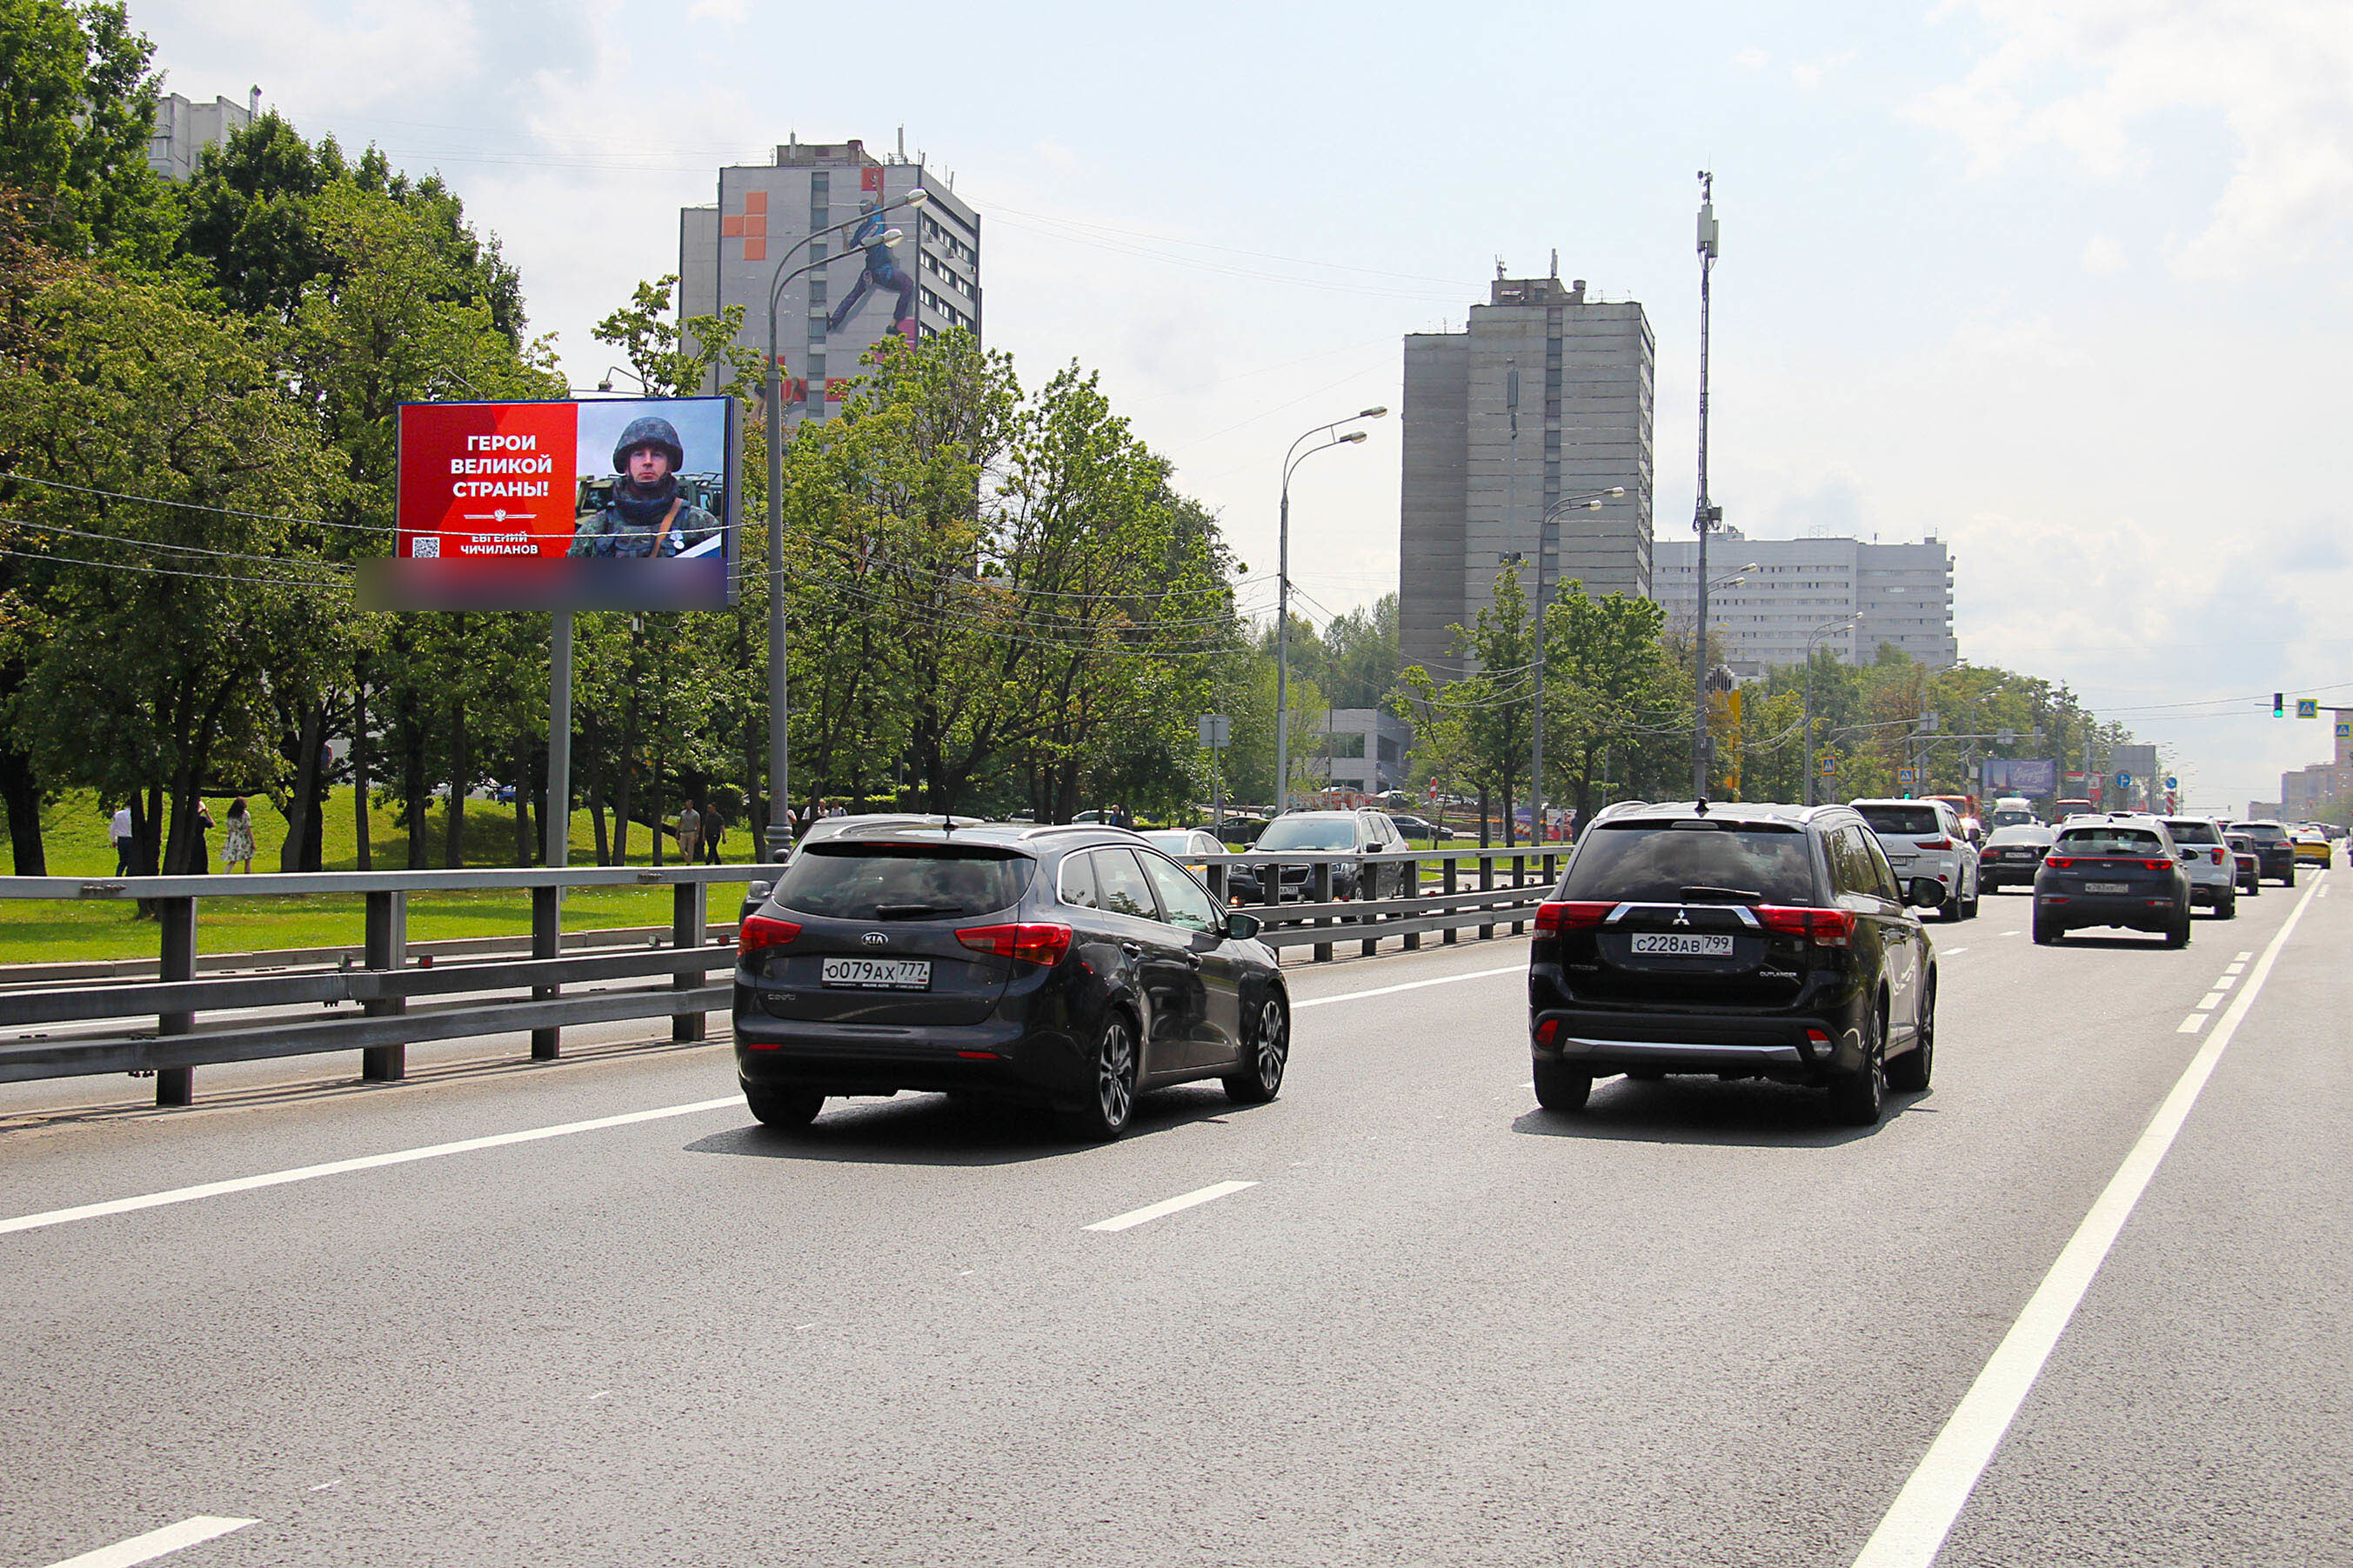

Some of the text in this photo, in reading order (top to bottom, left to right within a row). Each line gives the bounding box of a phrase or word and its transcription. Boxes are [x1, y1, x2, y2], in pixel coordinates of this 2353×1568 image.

[467, 435, 537, 451] ГЕРОИ
[451, 454, 552, 474] ВЕЛИКОЙ
[452, 481, 549, 497] СТРАНЫ!
[460, 544, 538, 555] ЧИЧИЛАНОВ
[864, 935, 884, 944] KIA
[1704, 937, 1729, 949] 799
[899, 963, 925, 977] 777
